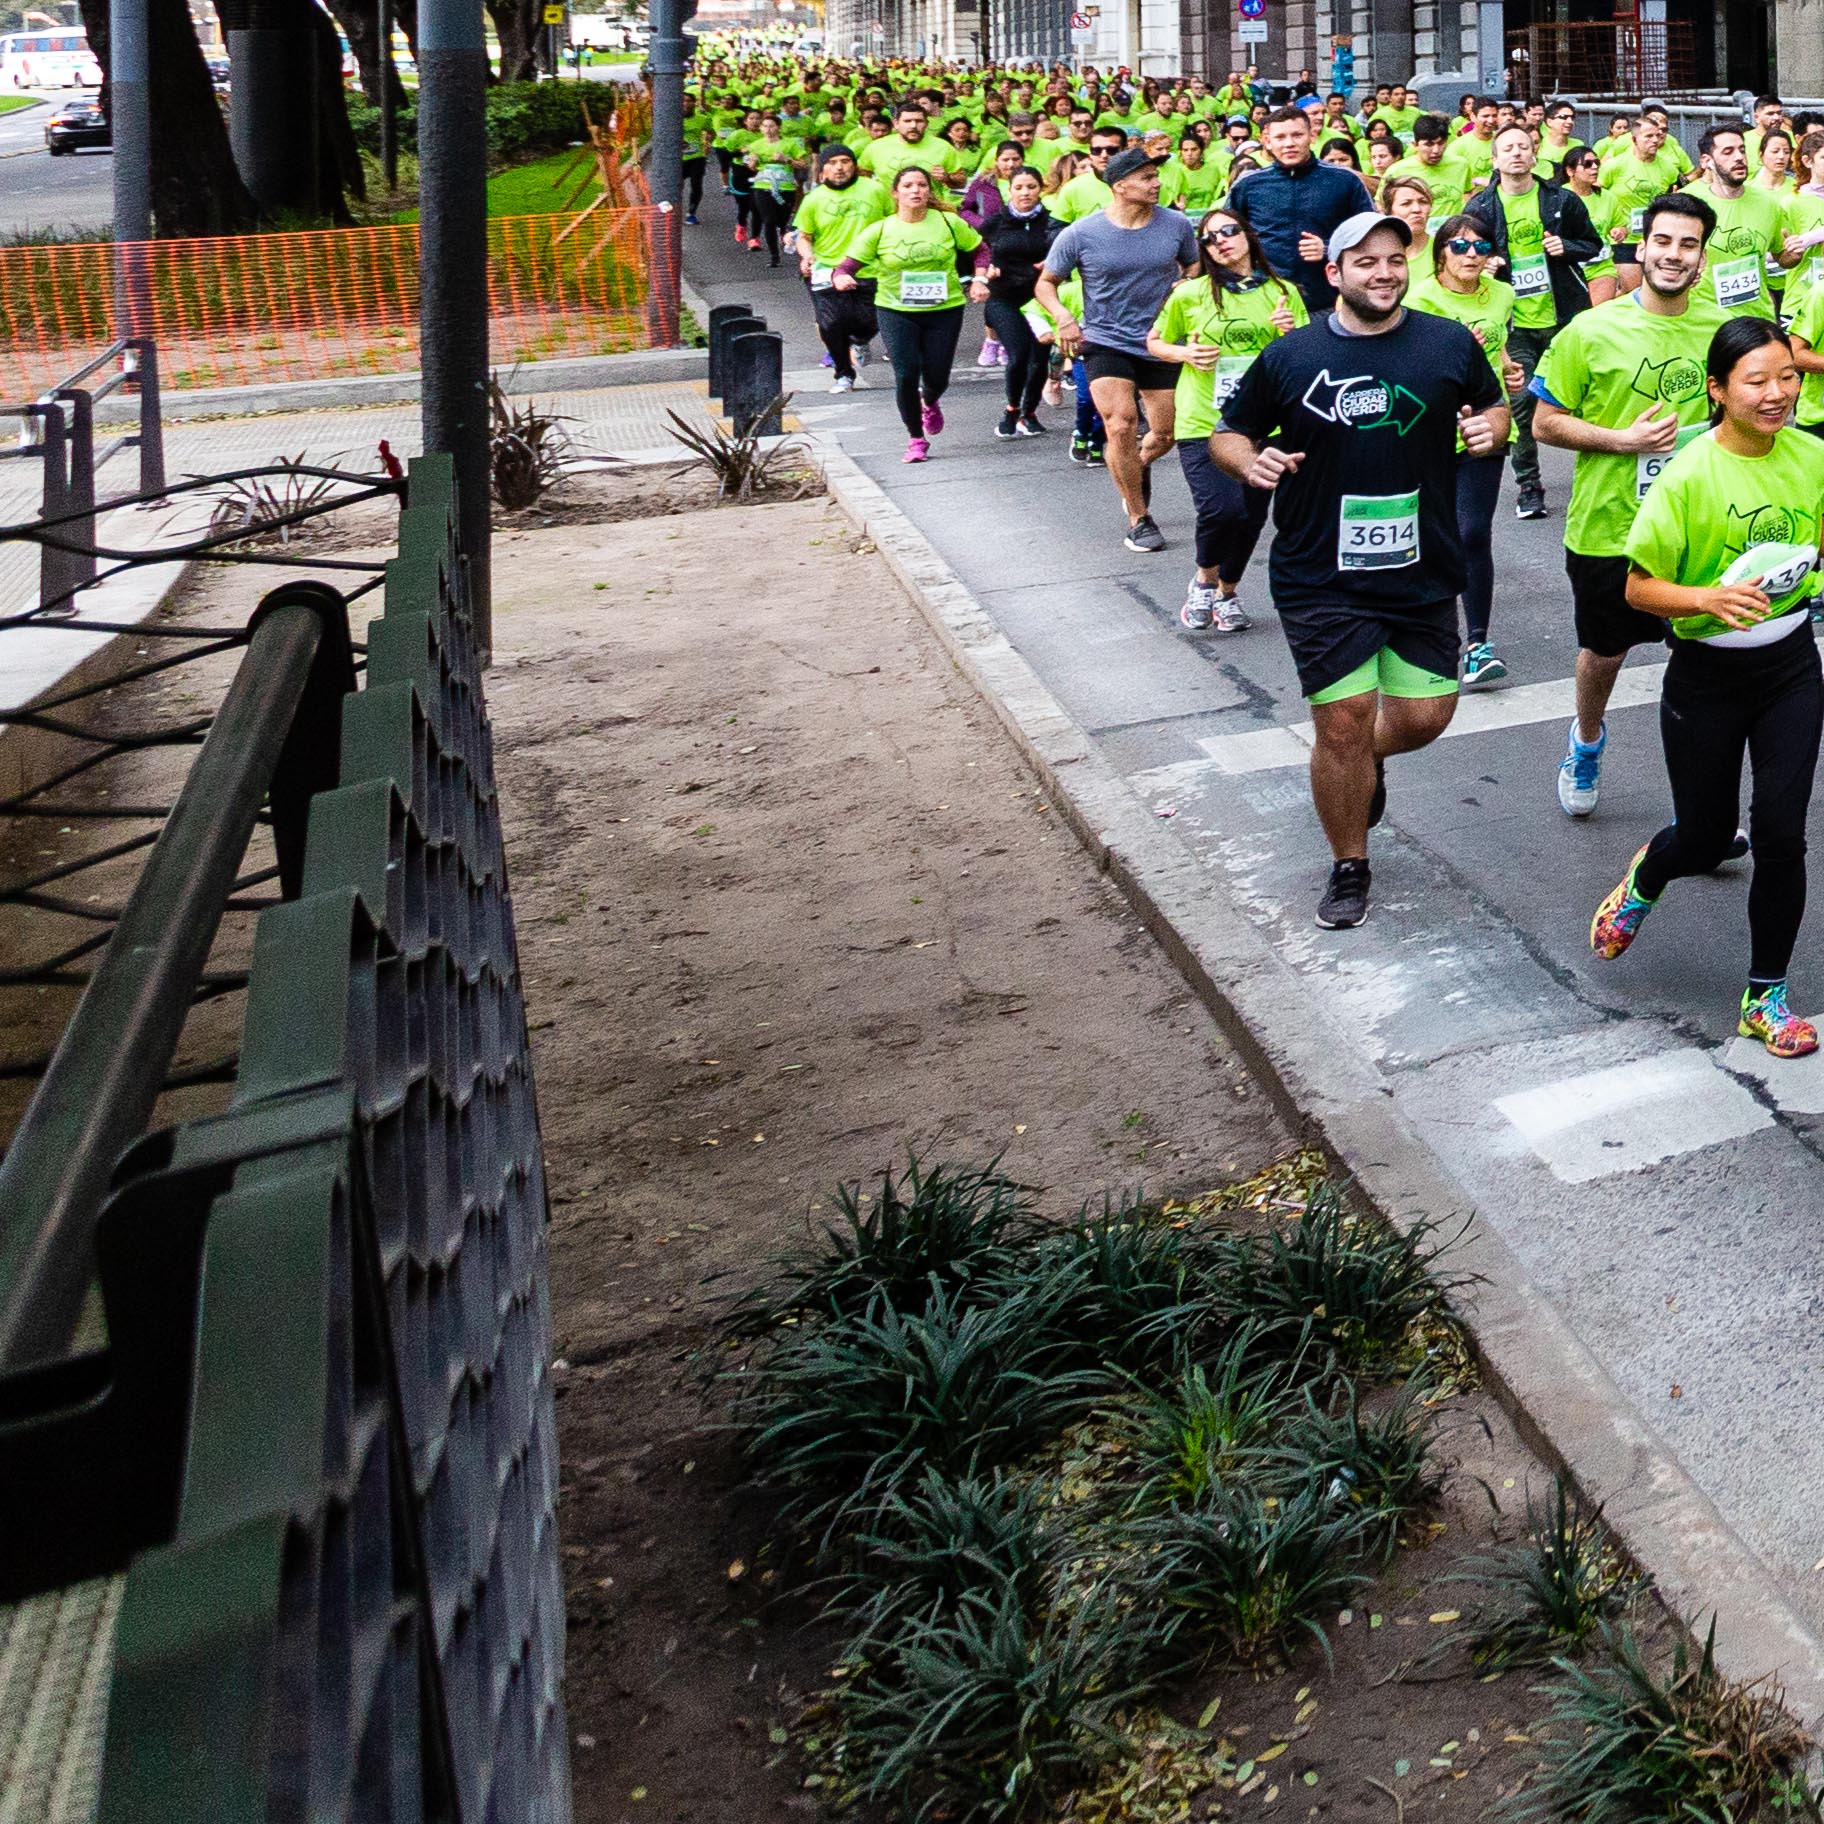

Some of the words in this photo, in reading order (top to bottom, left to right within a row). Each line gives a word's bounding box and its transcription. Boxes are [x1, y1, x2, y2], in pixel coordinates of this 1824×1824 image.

[1342, 394, 1388, 409] CIUDAD
[1342, 402, 1388, 418] VERDE
[1349, 521, 1415, 546] 3614
